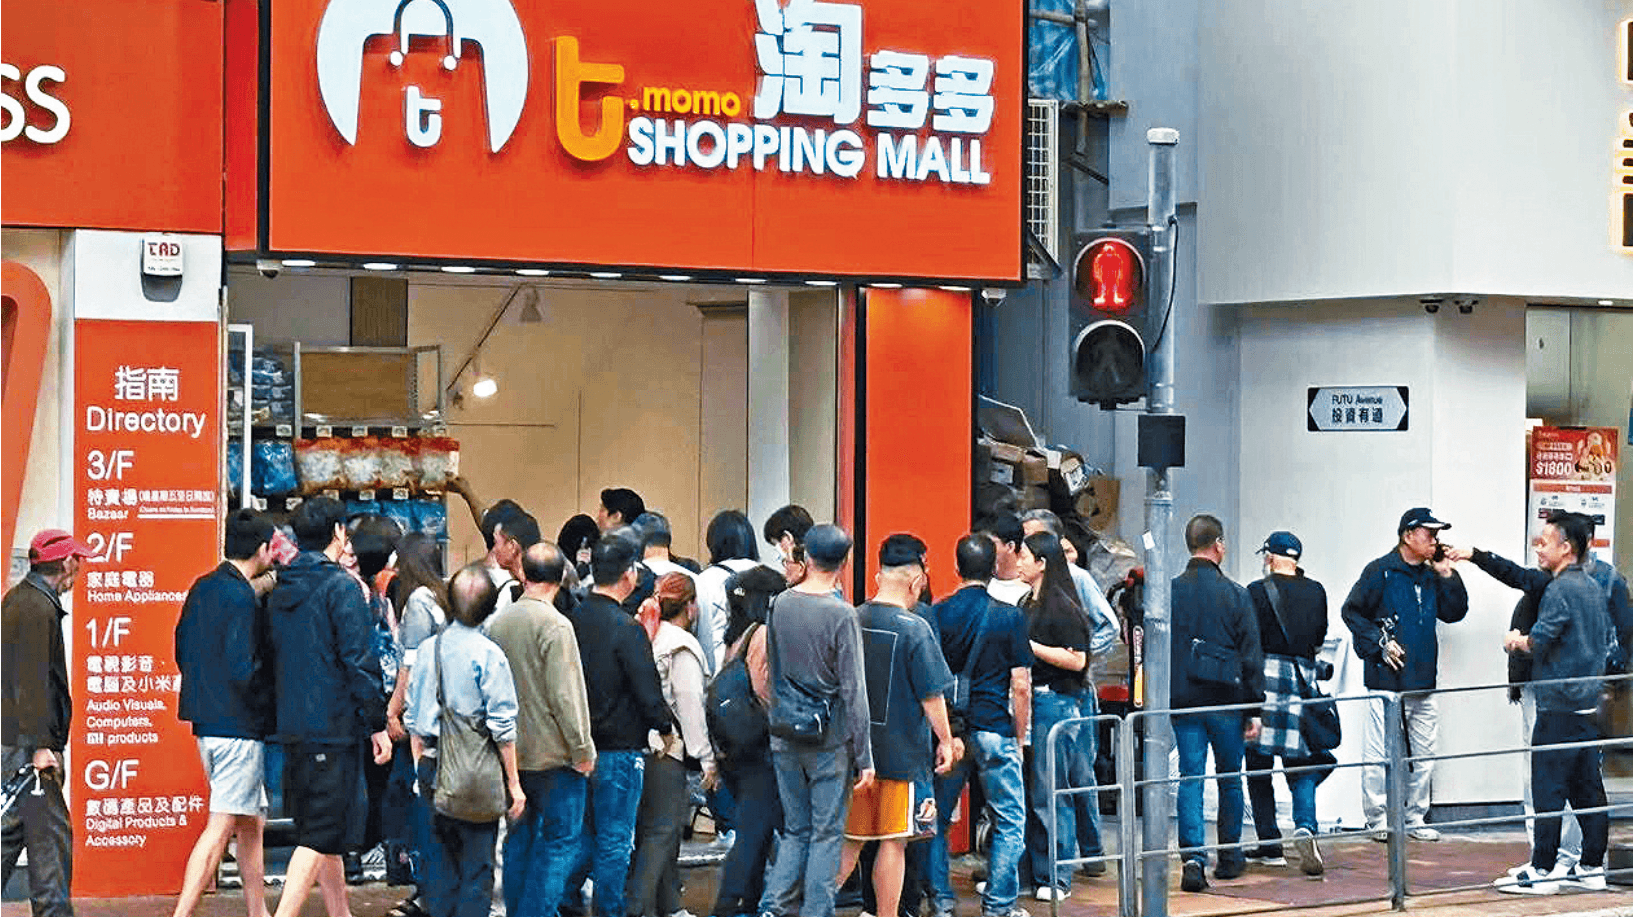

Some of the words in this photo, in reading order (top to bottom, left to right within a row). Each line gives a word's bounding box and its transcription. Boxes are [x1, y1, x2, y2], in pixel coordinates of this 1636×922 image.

[628, 118, 864, 179] SHOPPING
[877, 134, 991, 185] MALL
[114, 366, 180, 402] 指南
[1332, 394, 1353, 405] FUTU
[1355, 394, 1384, 405] Avenue
[87, 406, 206, 438] Directory
[88, 450, 134, 480] 3/F
[1535, 461, 1572, 476] $1800
[87, 507, 129, 519] Bazaar
[86, 532, 134, 563] 2/F
[87, 571, 155, 588] 家庭電器
[87, 590, 122, 602] Home
[86, 617, 132, 648] 1/F
[87, 699, 121, 712] Audio
[107, 732, 159, 746] products
[85, 760, 139, 790] G/F
[85, 796, 204, 817] 數碼產品及配件
[85, 816, 123, 832] Digital
[125, 815, 176, 829] Products
[85, 834, 147, 848] Accessory
